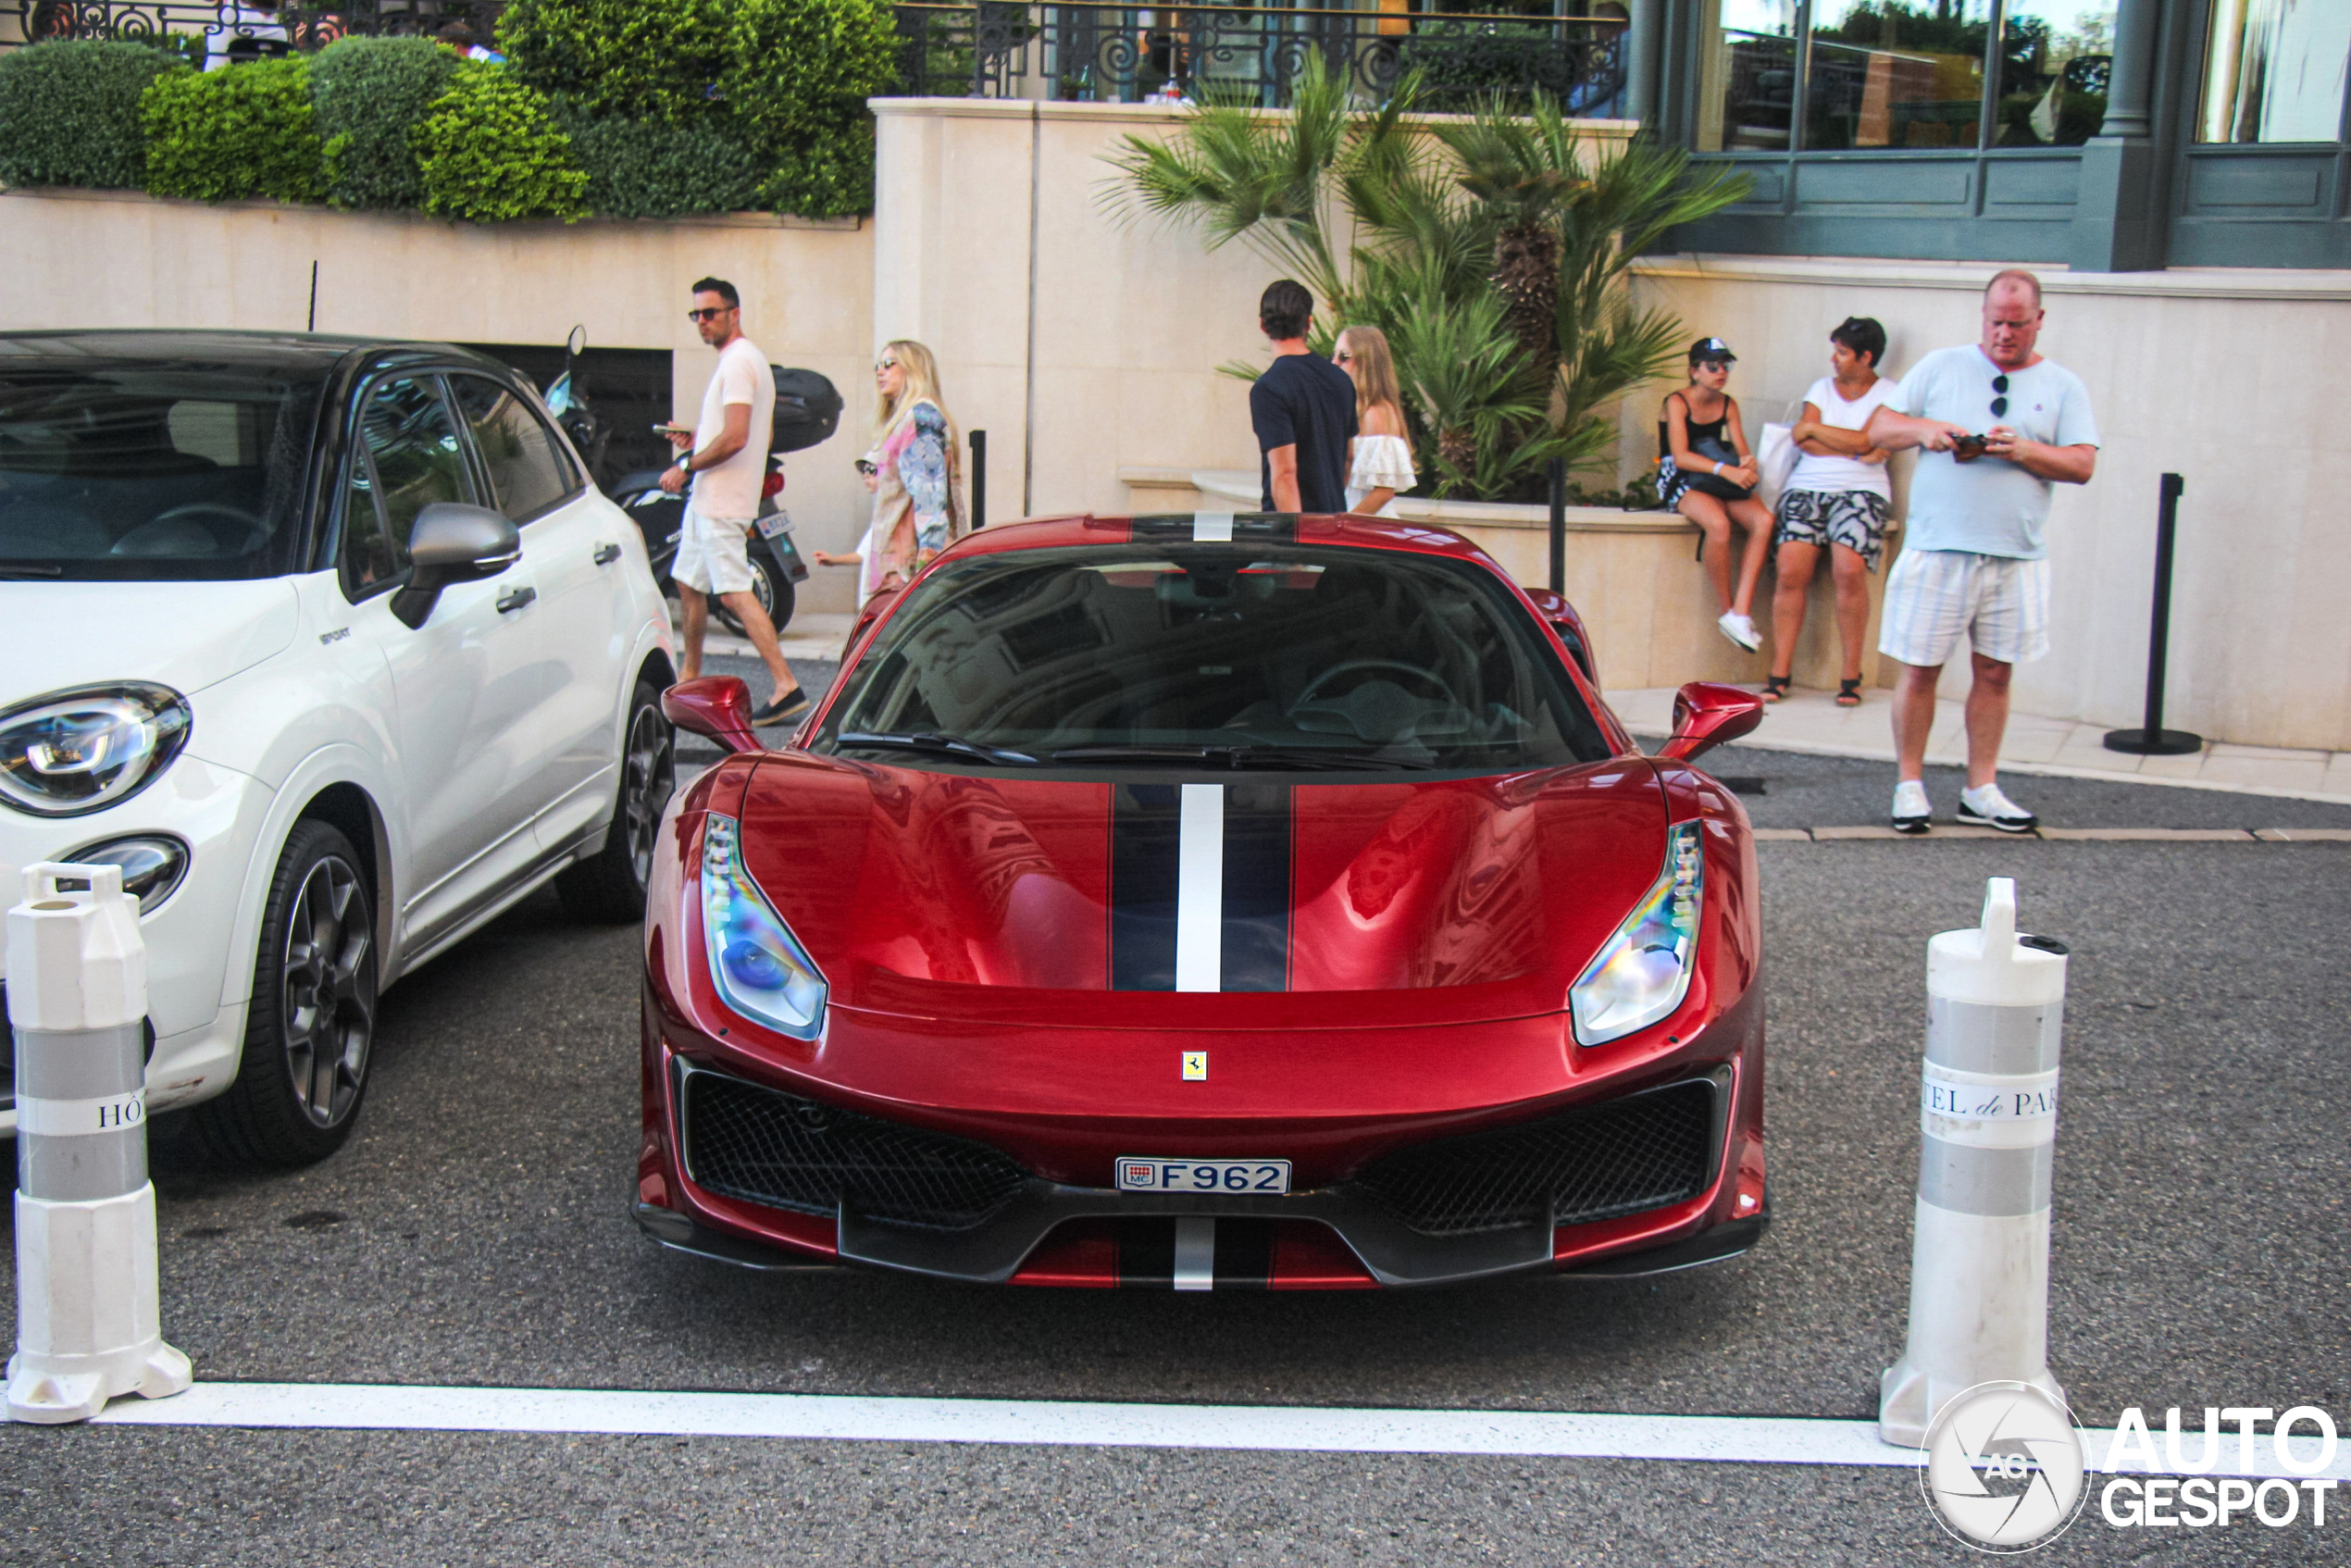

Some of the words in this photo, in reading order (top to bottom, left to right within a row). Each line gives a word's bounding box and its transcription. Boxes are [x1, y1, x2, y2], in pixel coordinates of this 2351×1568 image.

[318, 627, 351, 645] SPORT
[98, 1094, 145, 1128] HÔ
[1975, 1095, 2004, 1116] de
[1130, 1175, 1150, 1183] MC
[1162, 1164, 1280, 1190] F962
